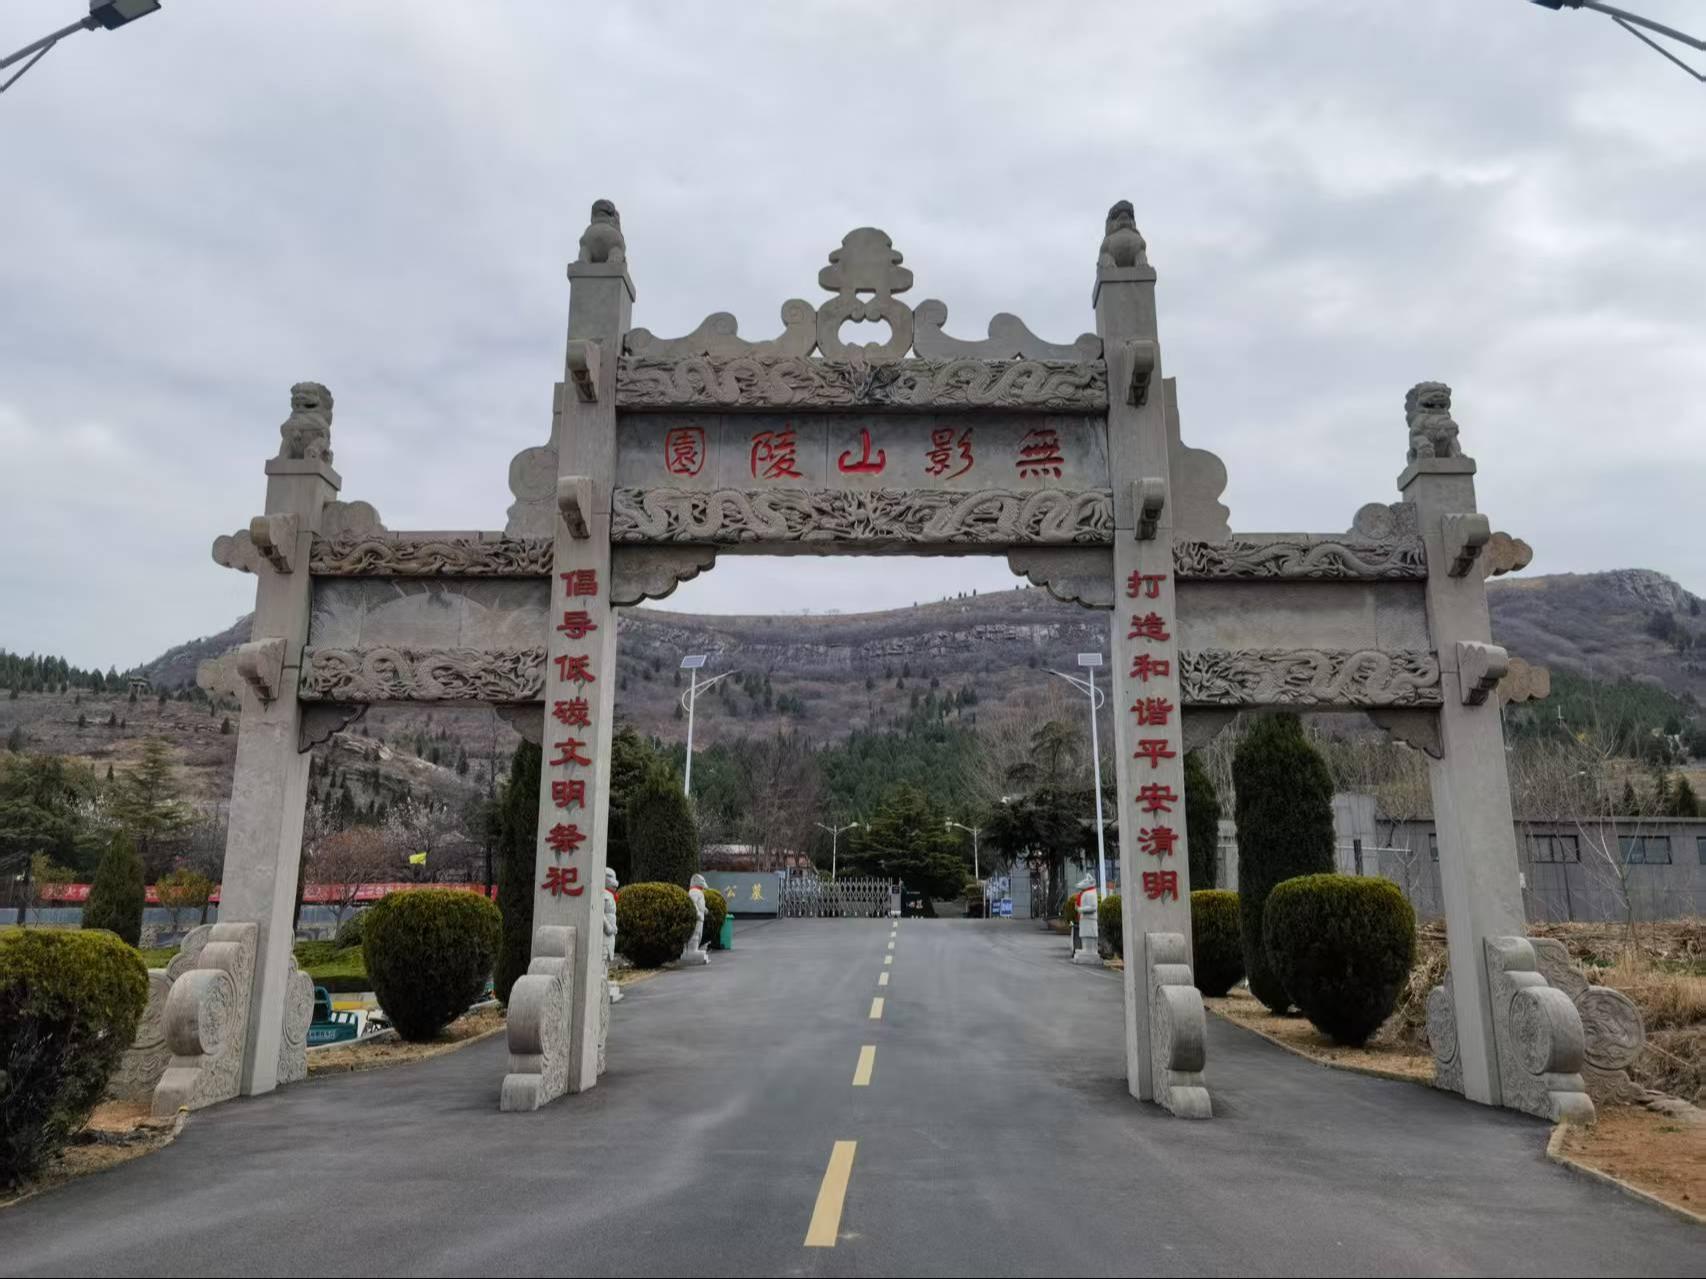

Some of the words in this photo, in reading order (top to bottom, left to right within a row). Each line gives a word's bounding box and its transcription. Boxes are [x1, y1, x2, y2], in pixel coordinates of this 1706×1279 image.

[541, 569, 598, 896] 倡导低碳文明祭祀
[1126, 570, 1178, 900] 打造和谐平安清明
